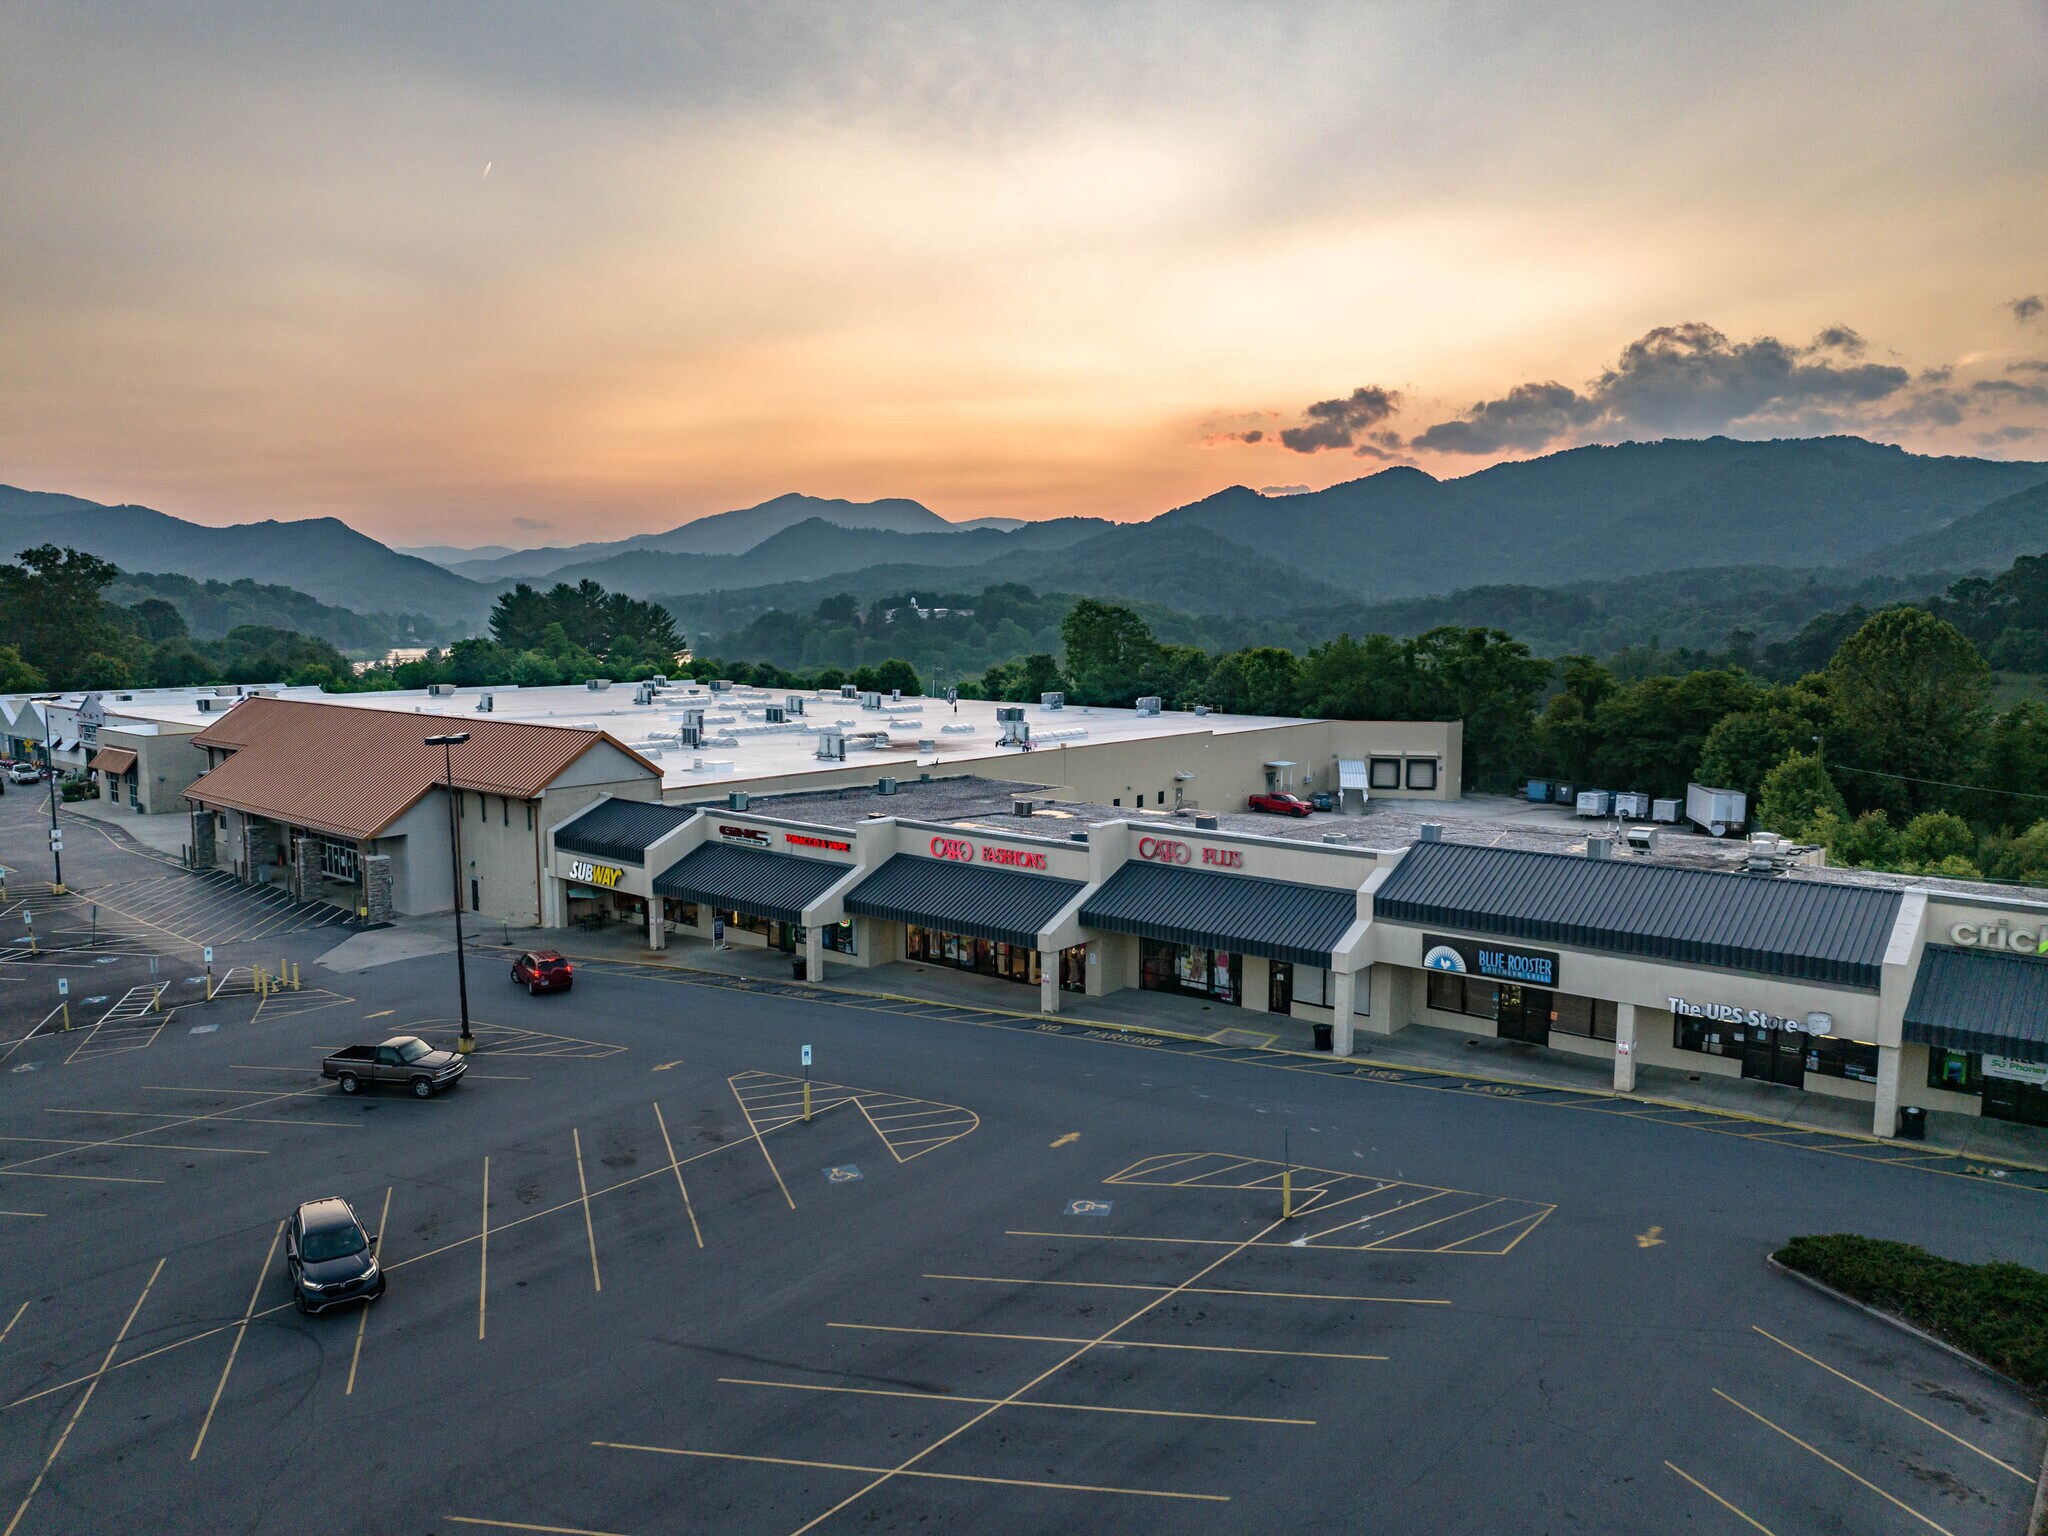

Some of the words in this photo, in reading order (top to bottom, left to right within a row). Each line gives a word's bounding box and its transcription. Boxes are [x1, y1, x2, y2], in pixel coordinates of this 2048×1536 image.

[719, 825, 769, 842] GNC
[785, 833, 820, 848] TOBACCO
[828, 841, 848, 852] VAPE
[930, 836, 973, 862] CATO
[982, 845, 1047, 870] FASHIONS
[1138, 837, 1191, 864] CATO
[1202, 847, 1242, 869] PLUS
[569, 861, 623, 888] SUBWAY
[1478, 949, 1505, 968] BLUE
[1508, 954, 1552, 976] ROOSTER
[1668, 996, 1702, 1017] The
[1707, 1002, 1744, 1024] UPS
[1748, 1009, 1798, 1033] Store
[1035, 1023, 1062, 1033] NO
[1084, 1029, 1163, 1046] PARKING
[1353, 1067, 1407, 1081] FIRE
[1462, 1082, 1527, 1097] LANE
[2009, 1062, 2047, 1075] Phones
